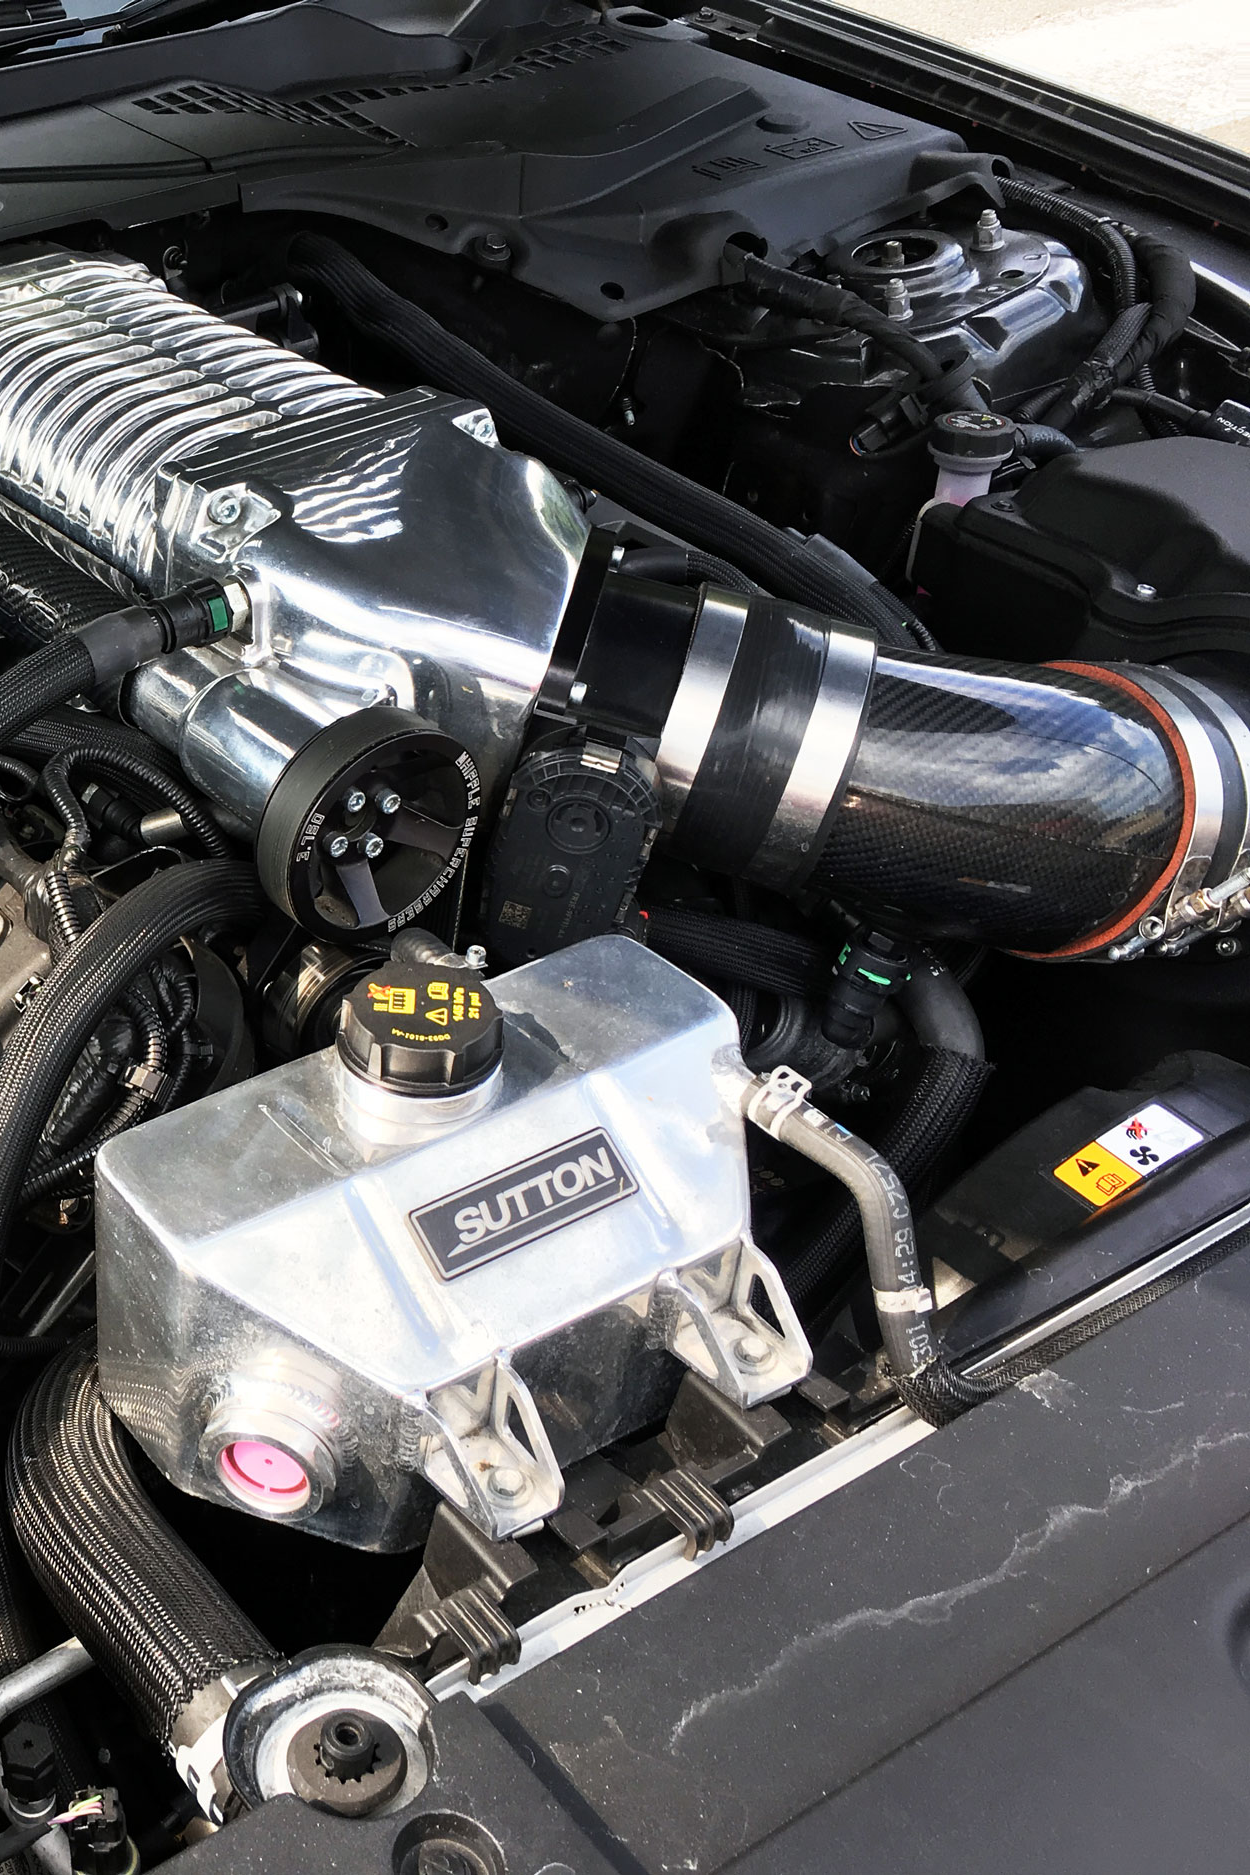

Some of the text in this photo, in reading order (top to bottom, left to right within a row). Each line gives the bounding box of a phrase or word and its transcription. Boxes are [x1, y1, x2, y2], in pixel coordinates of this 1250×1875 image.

[387, 750, 482, 933] WHIPPLE SUPERCHARGERS
[452, 1004, 465, 1022] 145
[468, 1007, 480, 1020] 21
[454, 1146, 615, 1243] SUTTON
